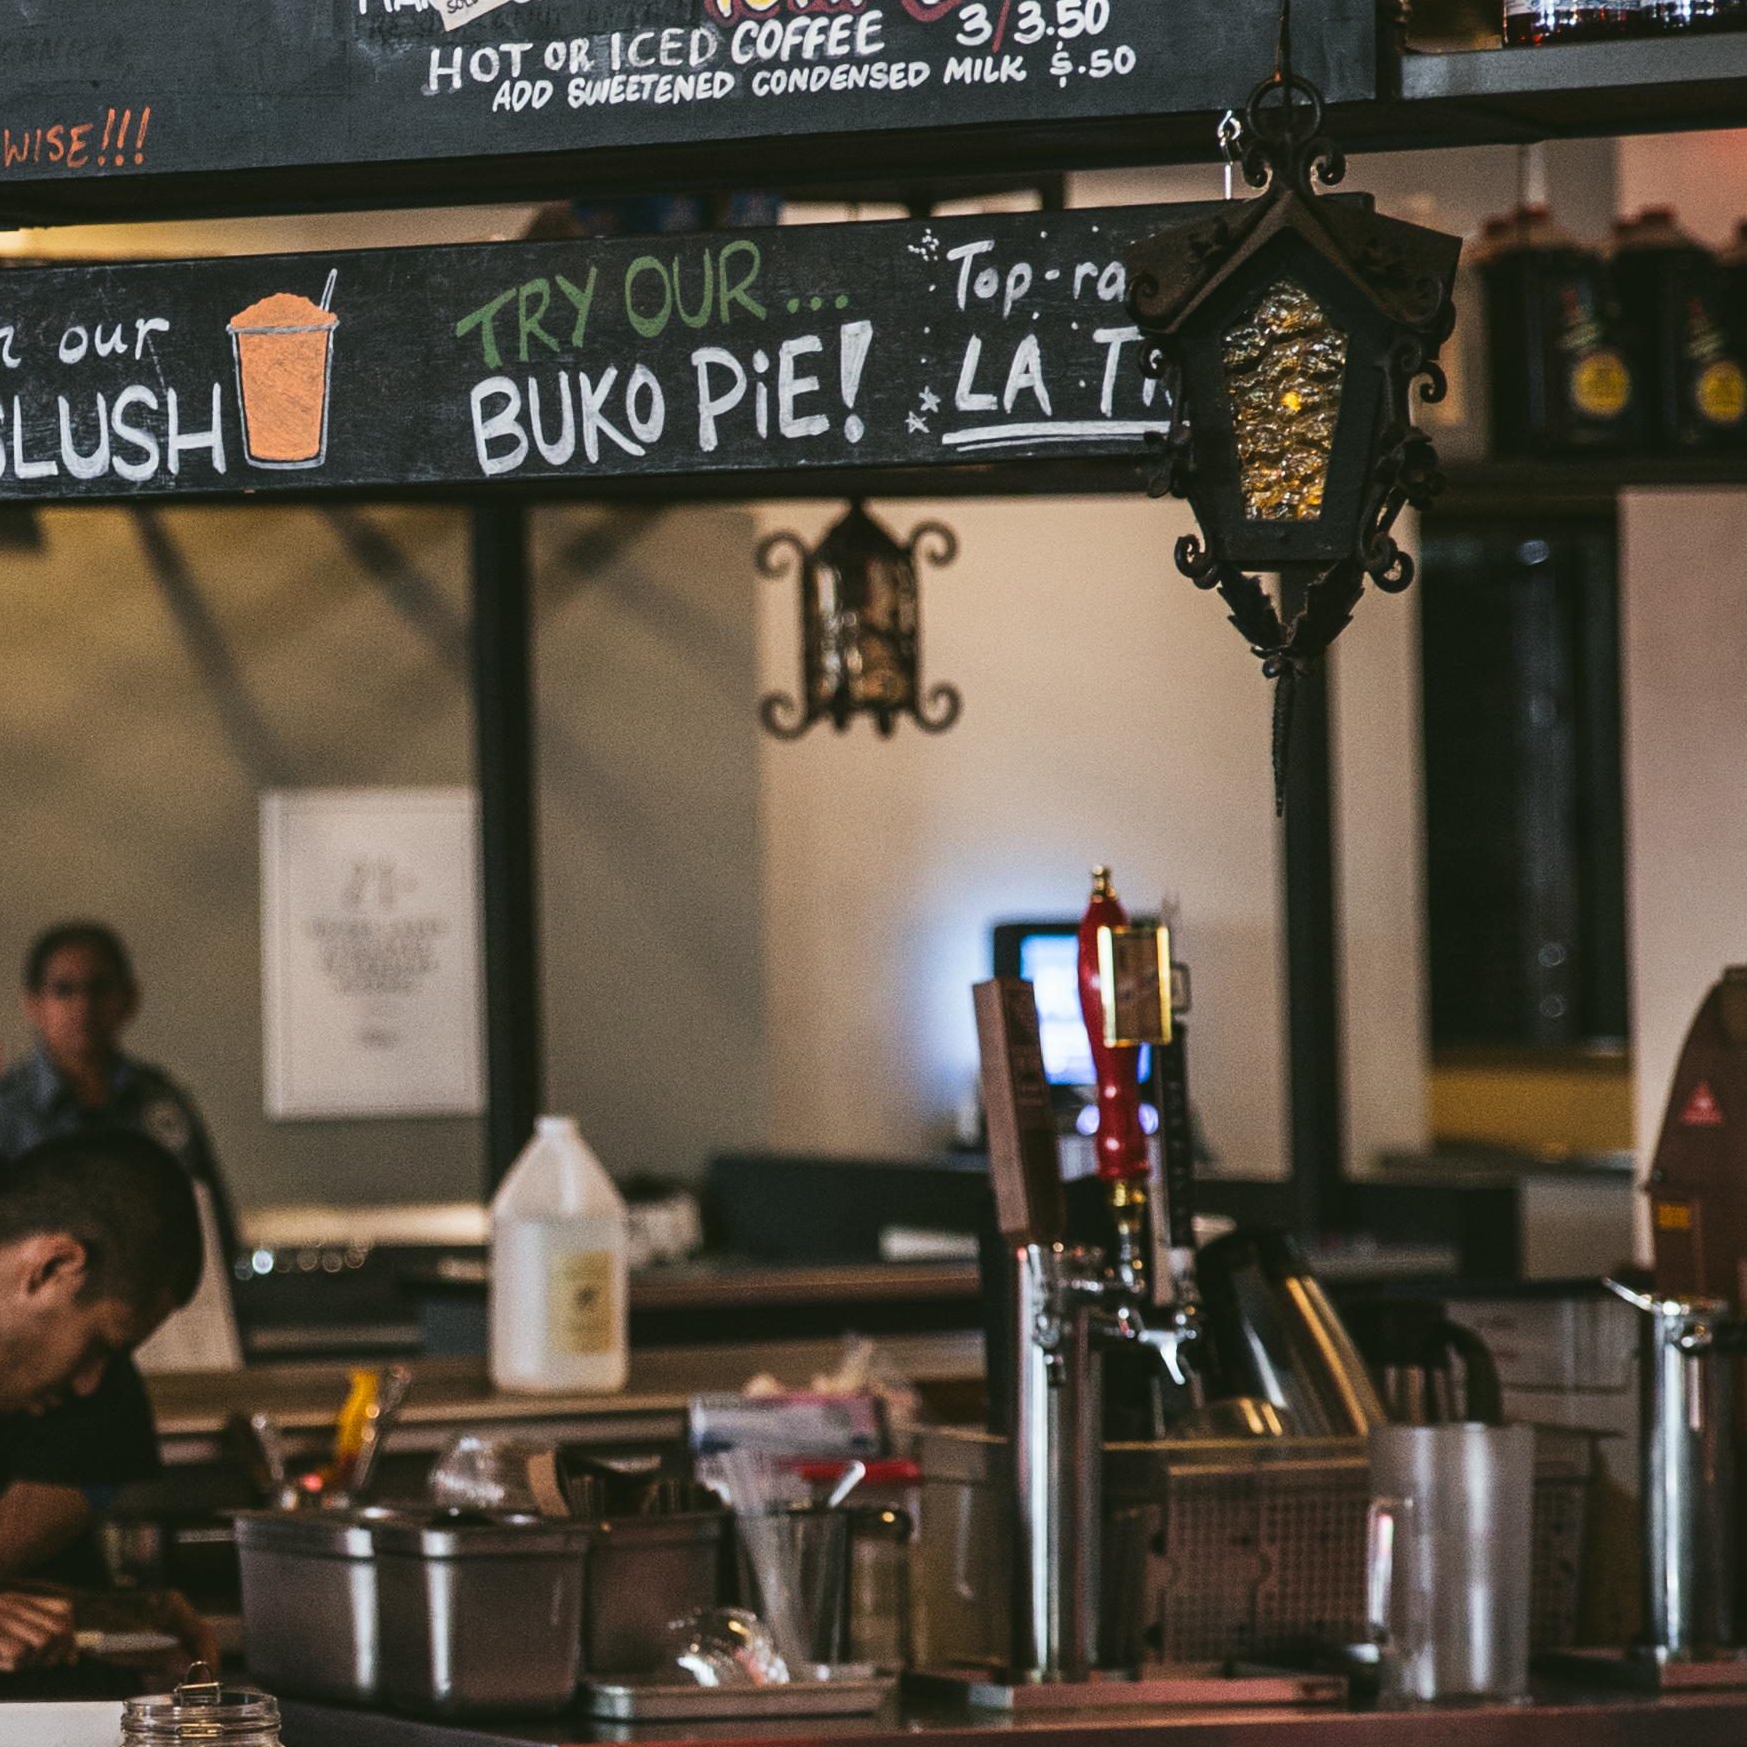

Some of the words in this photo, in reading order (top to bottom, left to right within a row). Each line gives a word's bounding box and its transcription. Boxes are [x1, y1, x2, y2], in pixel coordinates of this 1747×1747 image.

[429, 41, 534, 94] HOT
[610, 20, 719, 67] ICED
[731, 11, 886, 61] COFFEE
[492, 75, 559, 114] ADD
[565, 70, 737, 110] SWEETENED
[750, 61, 932, 96] CONDENSED
[942, 53, 1028, 85] MILK
[58, 316, 169, 364] our
[456, 269, 597, 369] TRY
[955, 334, 1052, 416] LA
[470, 363, 661, 477] BUKO
